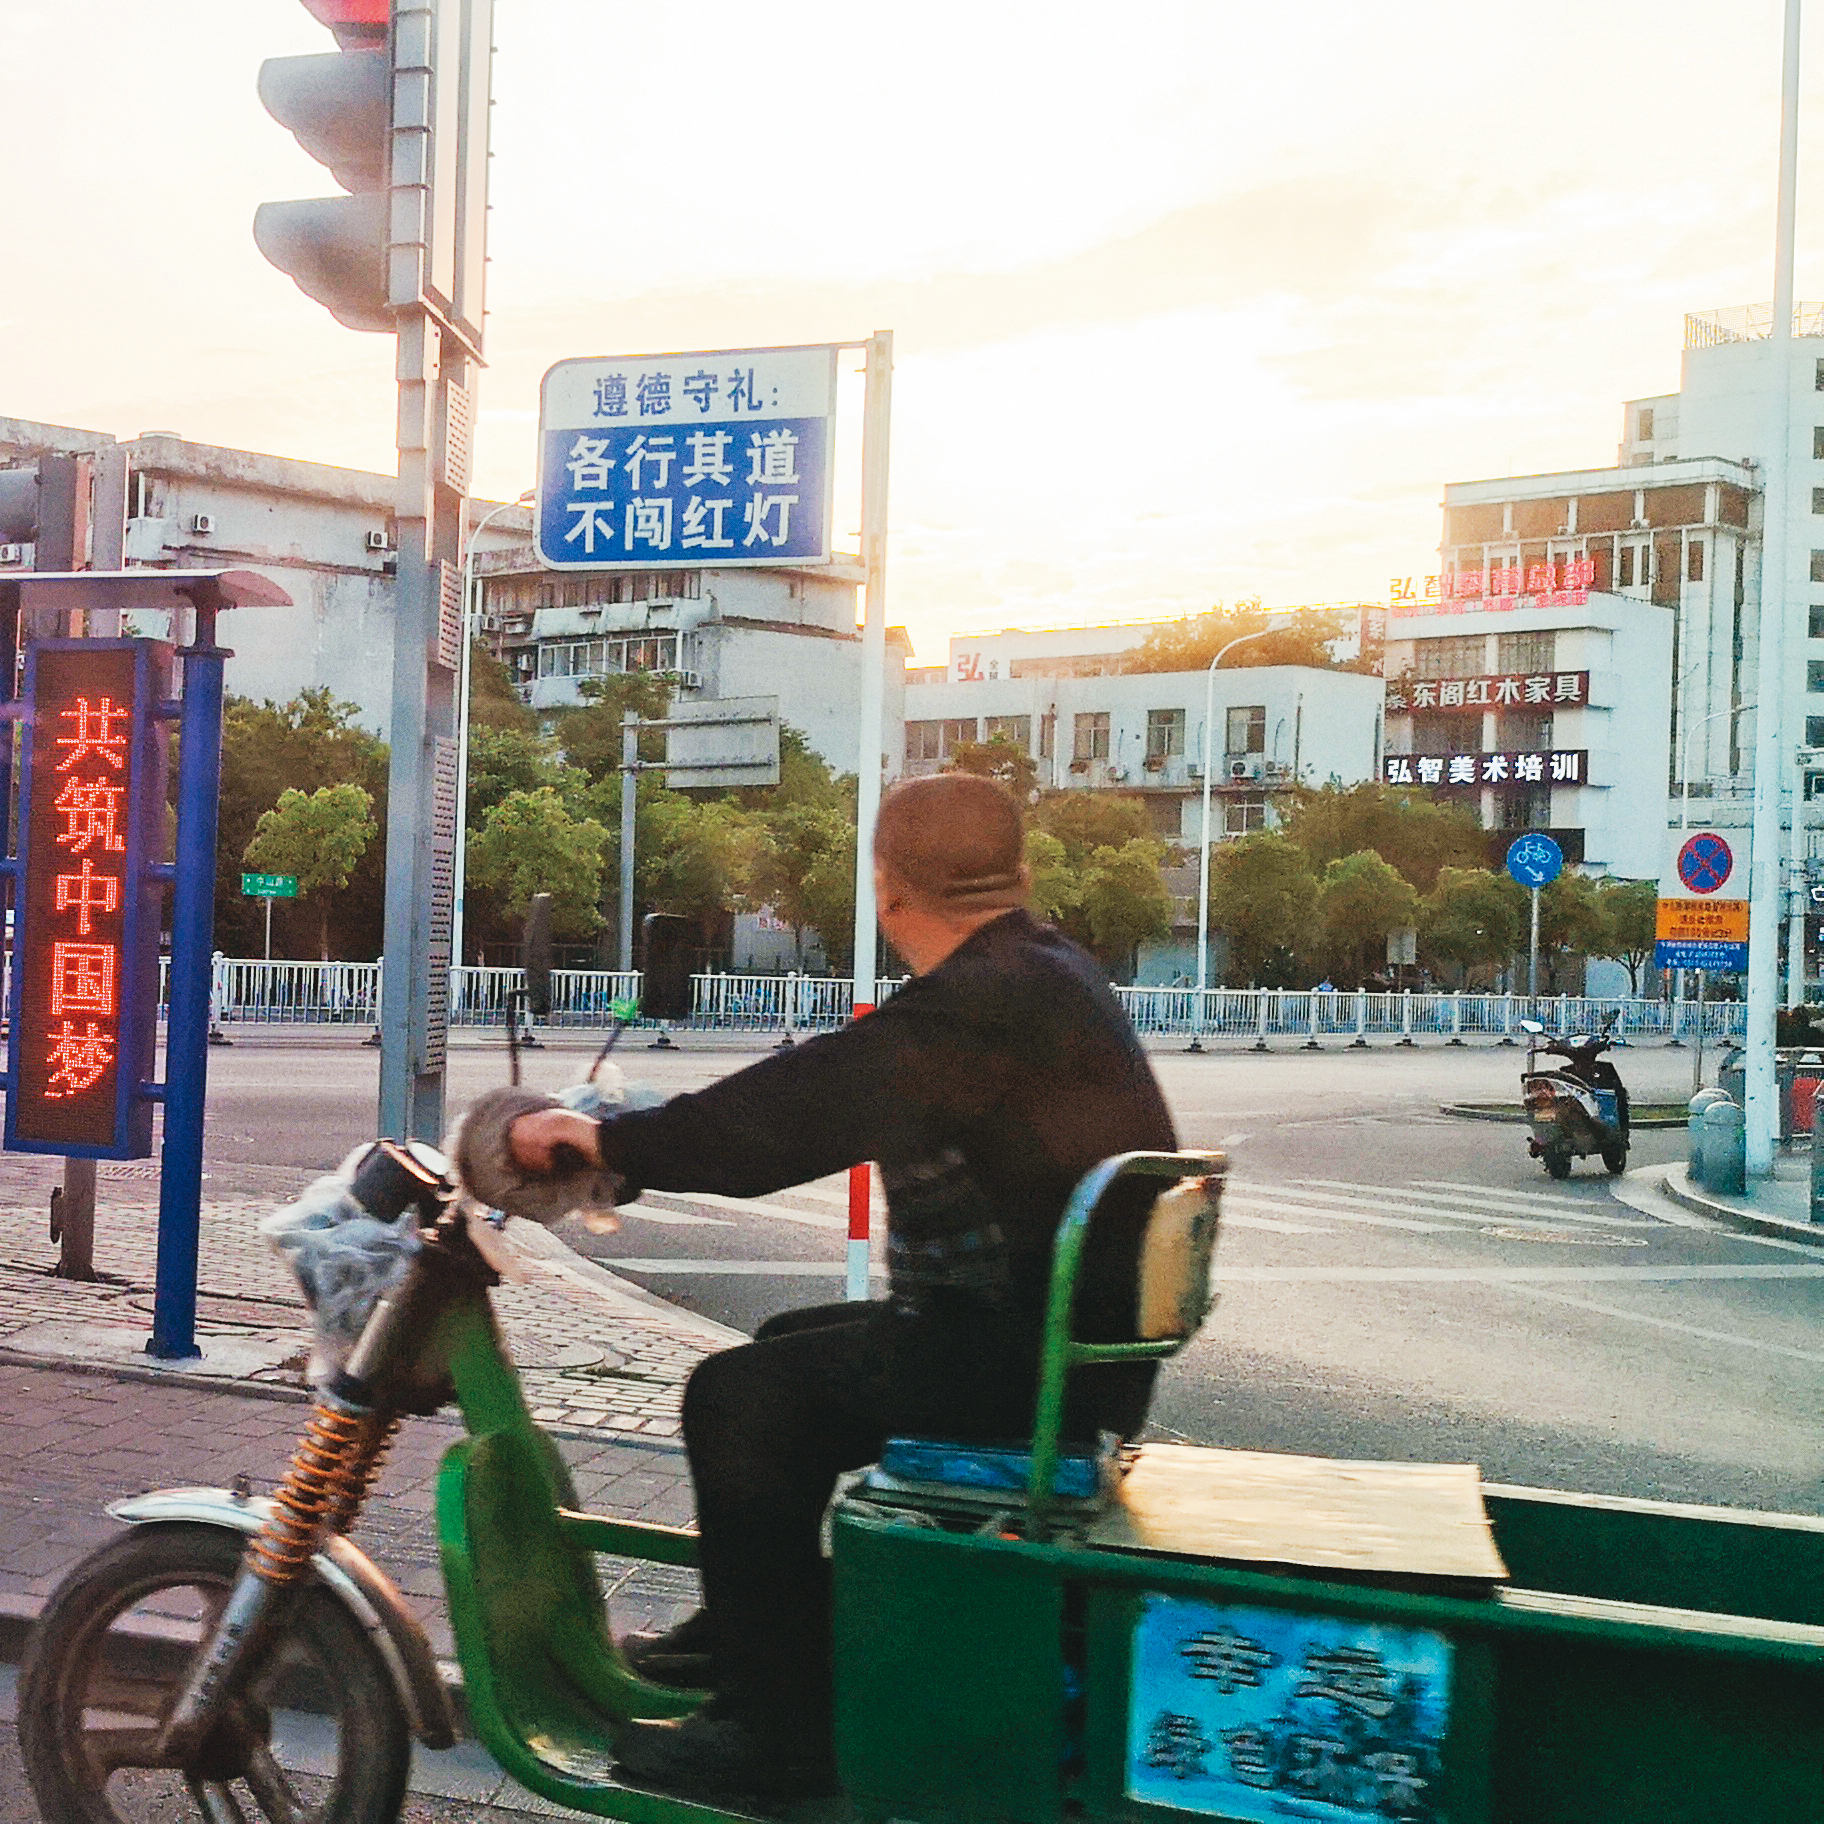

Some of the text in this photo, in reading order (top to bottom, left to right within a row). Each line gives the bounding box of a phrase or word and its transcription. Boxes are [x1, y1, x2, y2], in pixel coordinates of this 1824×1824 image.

[565, 427, 801, 492] 各行其道
[564, 491, 801, 554] 不闯红灯
[1387, 753, 1580, 785] 弘智美术培训
[43, 697, 129, 1098] 共筑中国梦
